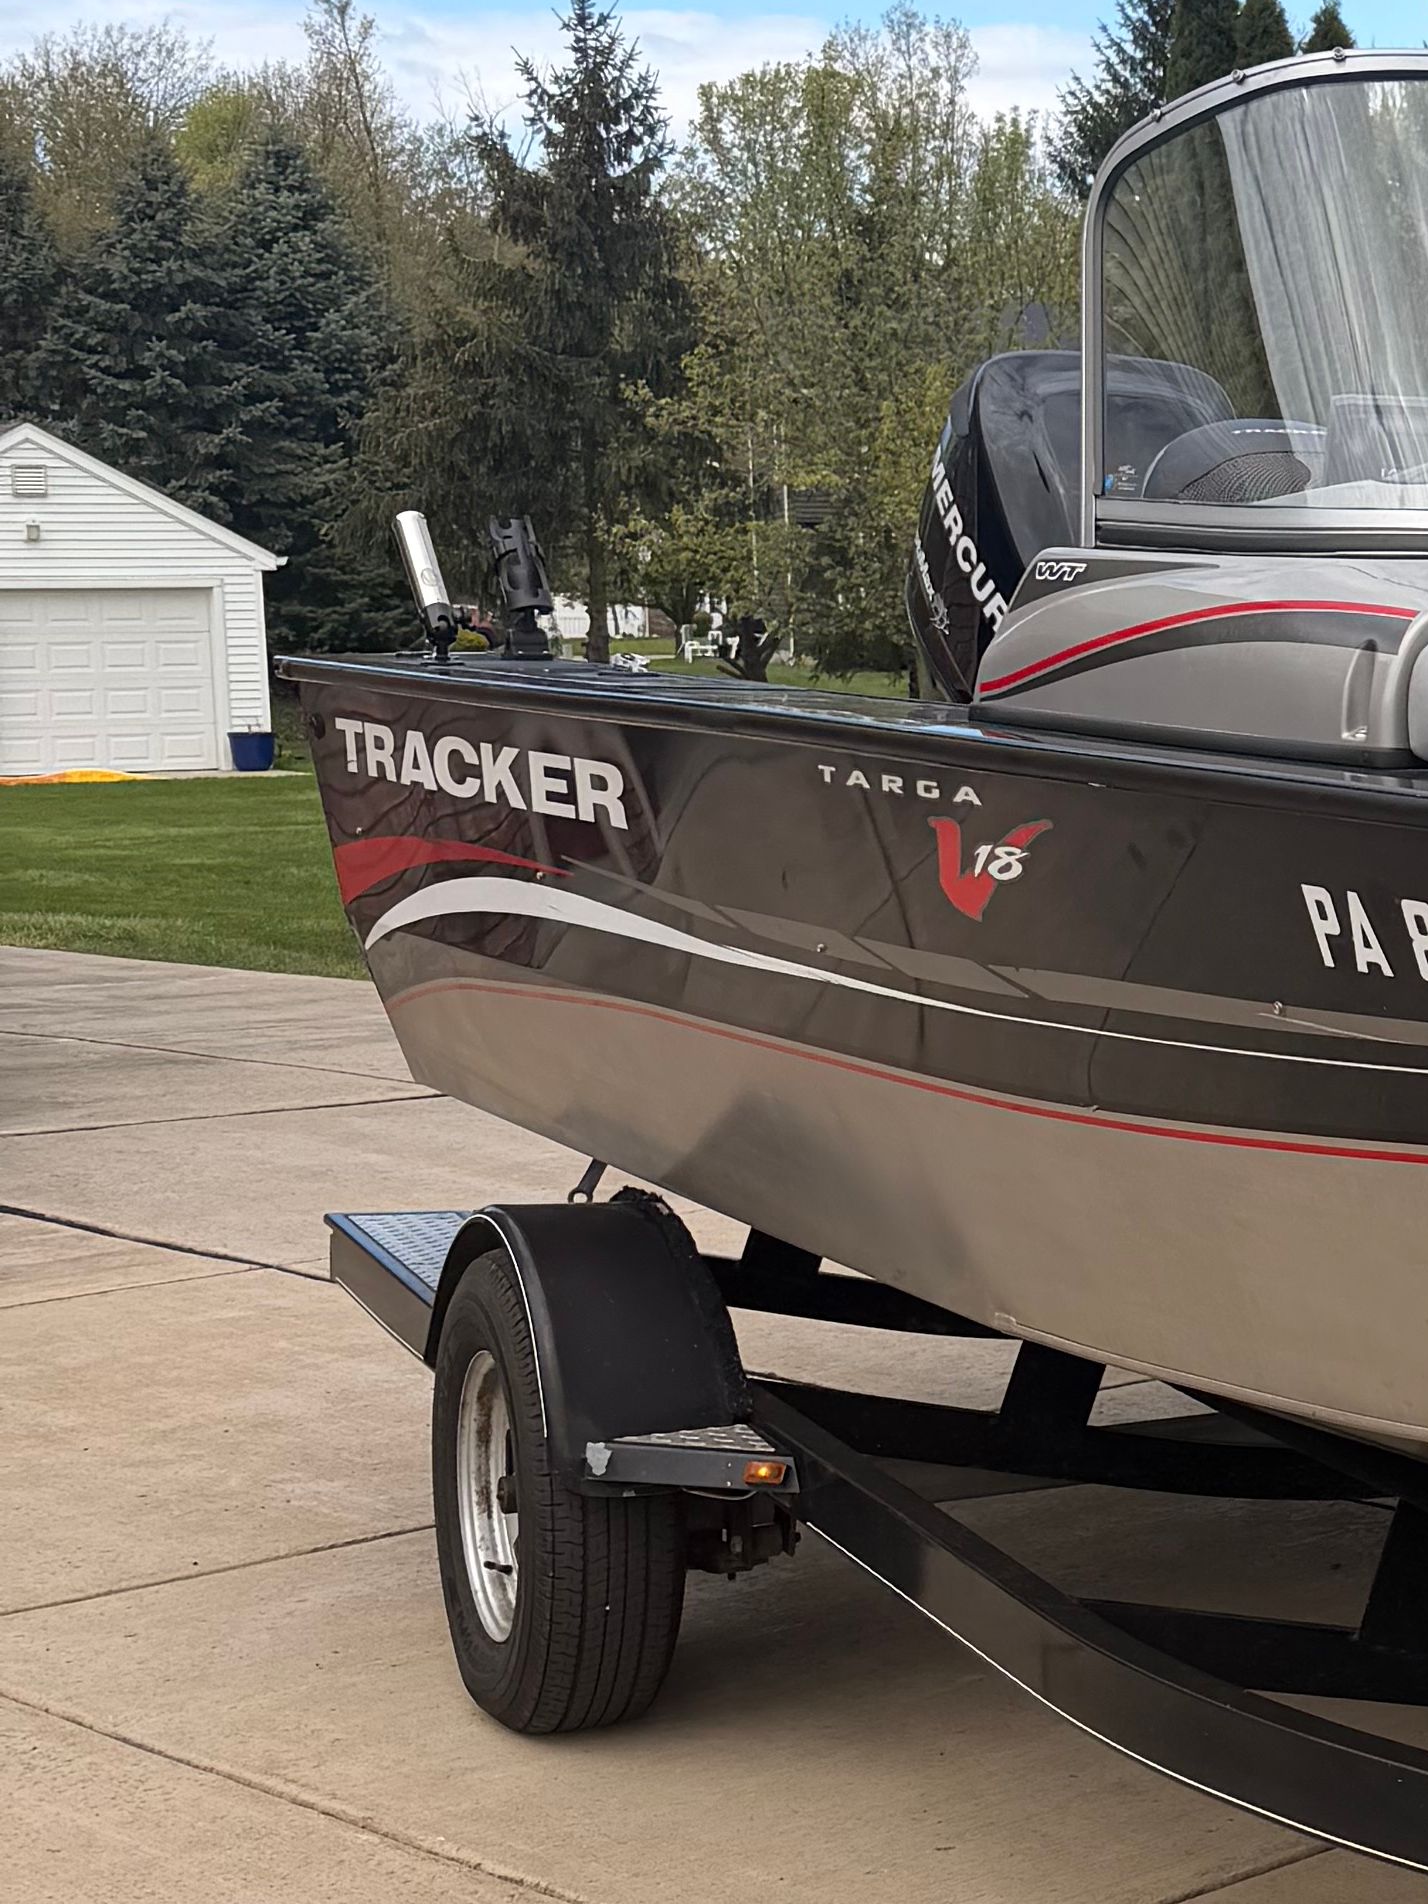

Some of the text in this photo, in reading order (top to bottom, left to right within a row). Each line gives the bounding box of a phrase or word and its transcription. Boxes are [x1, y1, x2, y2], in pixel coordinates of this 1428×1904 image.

[932, 444, 1009, 633] MERCUR
[1036, 561, 1087, 581] WT
[335, 718, 629, 830] TRACKER
[818, 764, 982, 807] TARGA
[1301, 883, 1394, 978] PA
